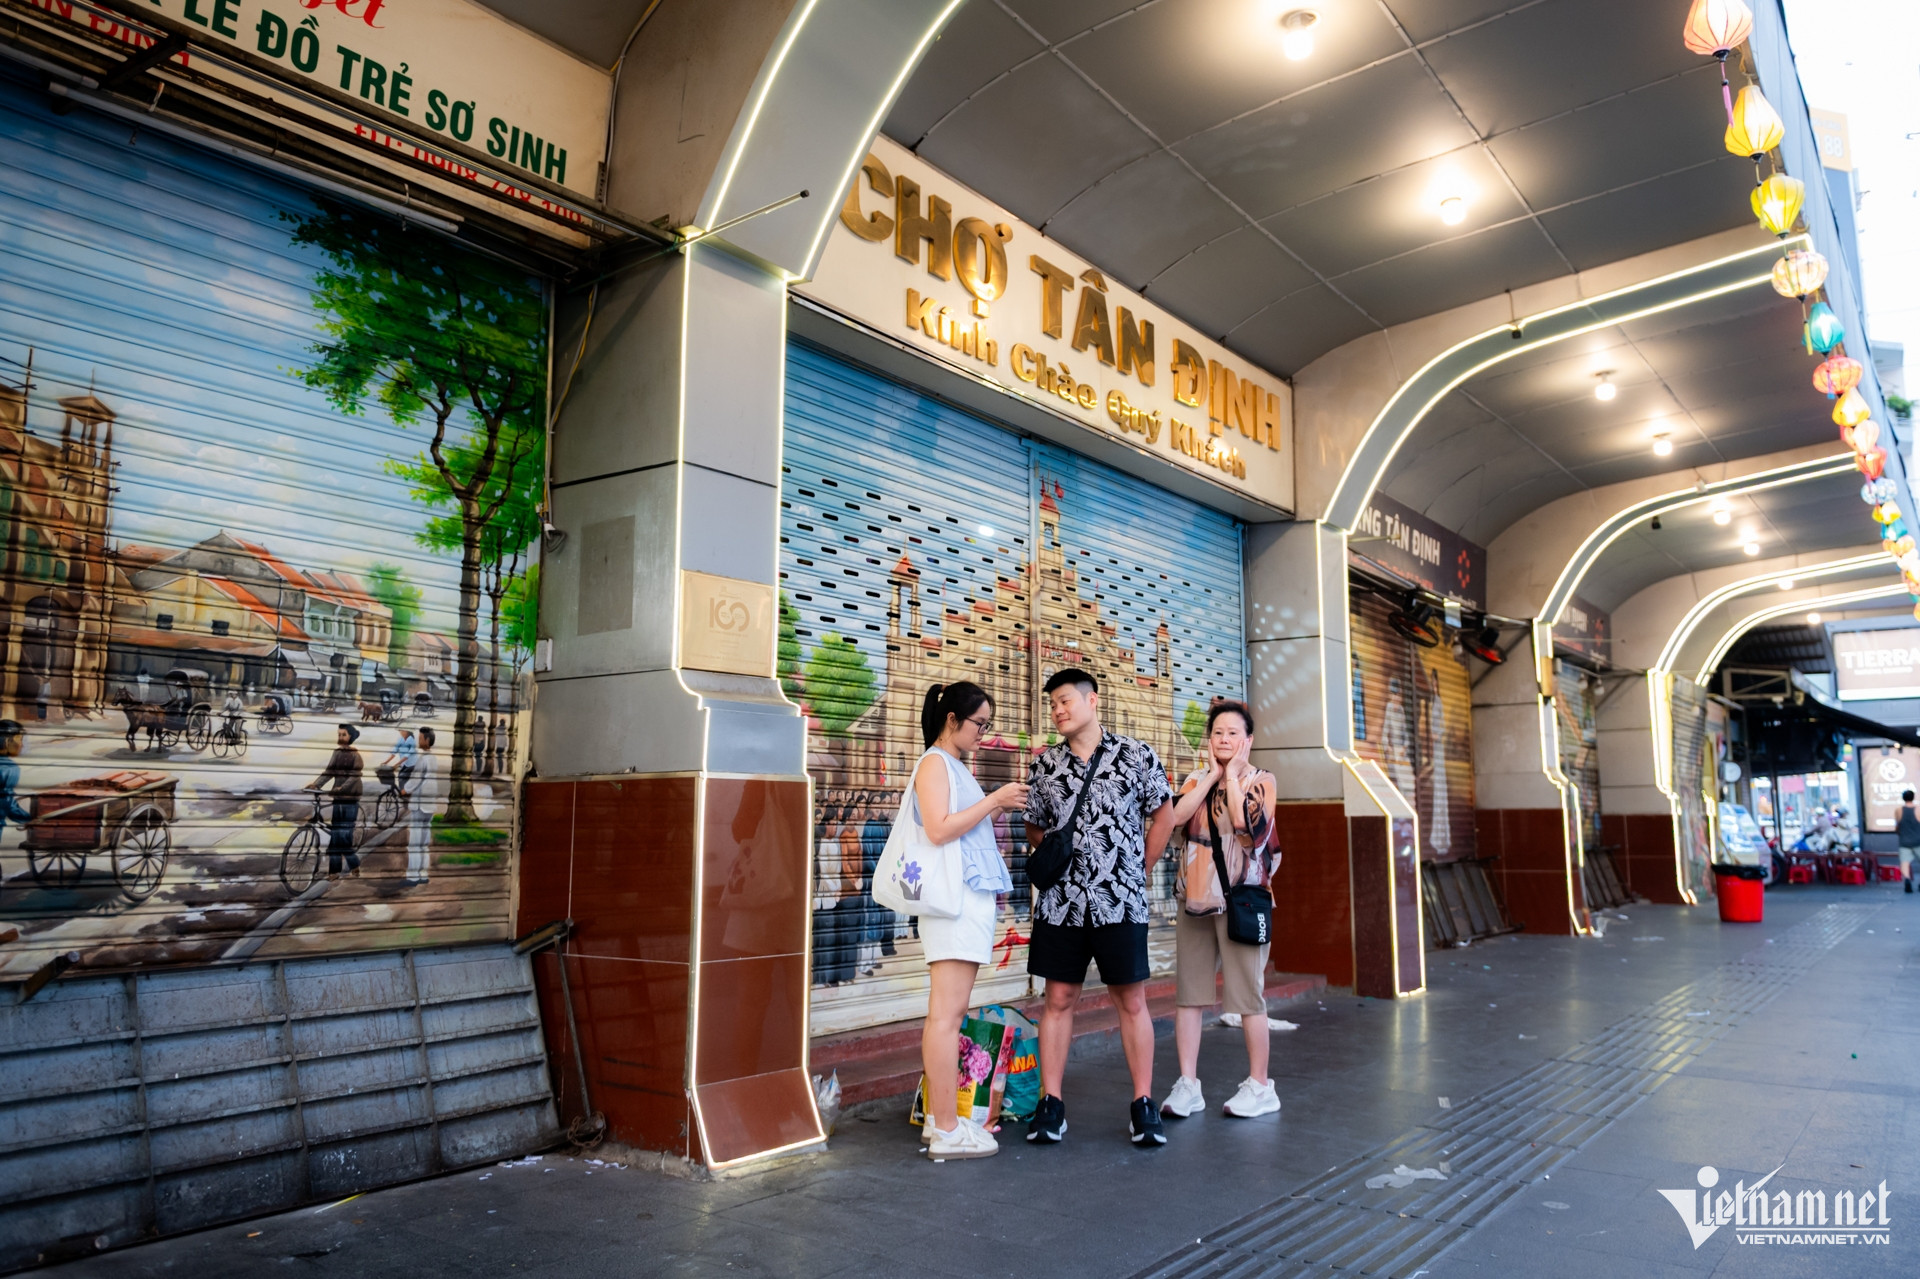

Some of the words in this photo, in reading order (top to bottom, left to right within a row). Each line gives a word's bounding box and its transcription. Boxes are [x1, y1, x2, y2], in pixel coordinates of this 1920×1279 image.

[255, 9, 320, 74] ĐỒ
[336, 44, 413, 117] TRẺ
[425, 88, 476, 142] SƠ
[486, 117, 568, 185] SINH
[839, 153, 1013, 318] CHỢ
[1029, 254, 1156, 387] TÂN
[1170, 338, 1281, 452] ĐỊNH
[906, 287, 998, 367] Kính
[1010, 343, 1098, 410] Chào
[1106, 388, 1163, 445] Quý
[1170, 417, 1247, 480] Khách
[1412, 528, 1441, 566] ĐỊNH
